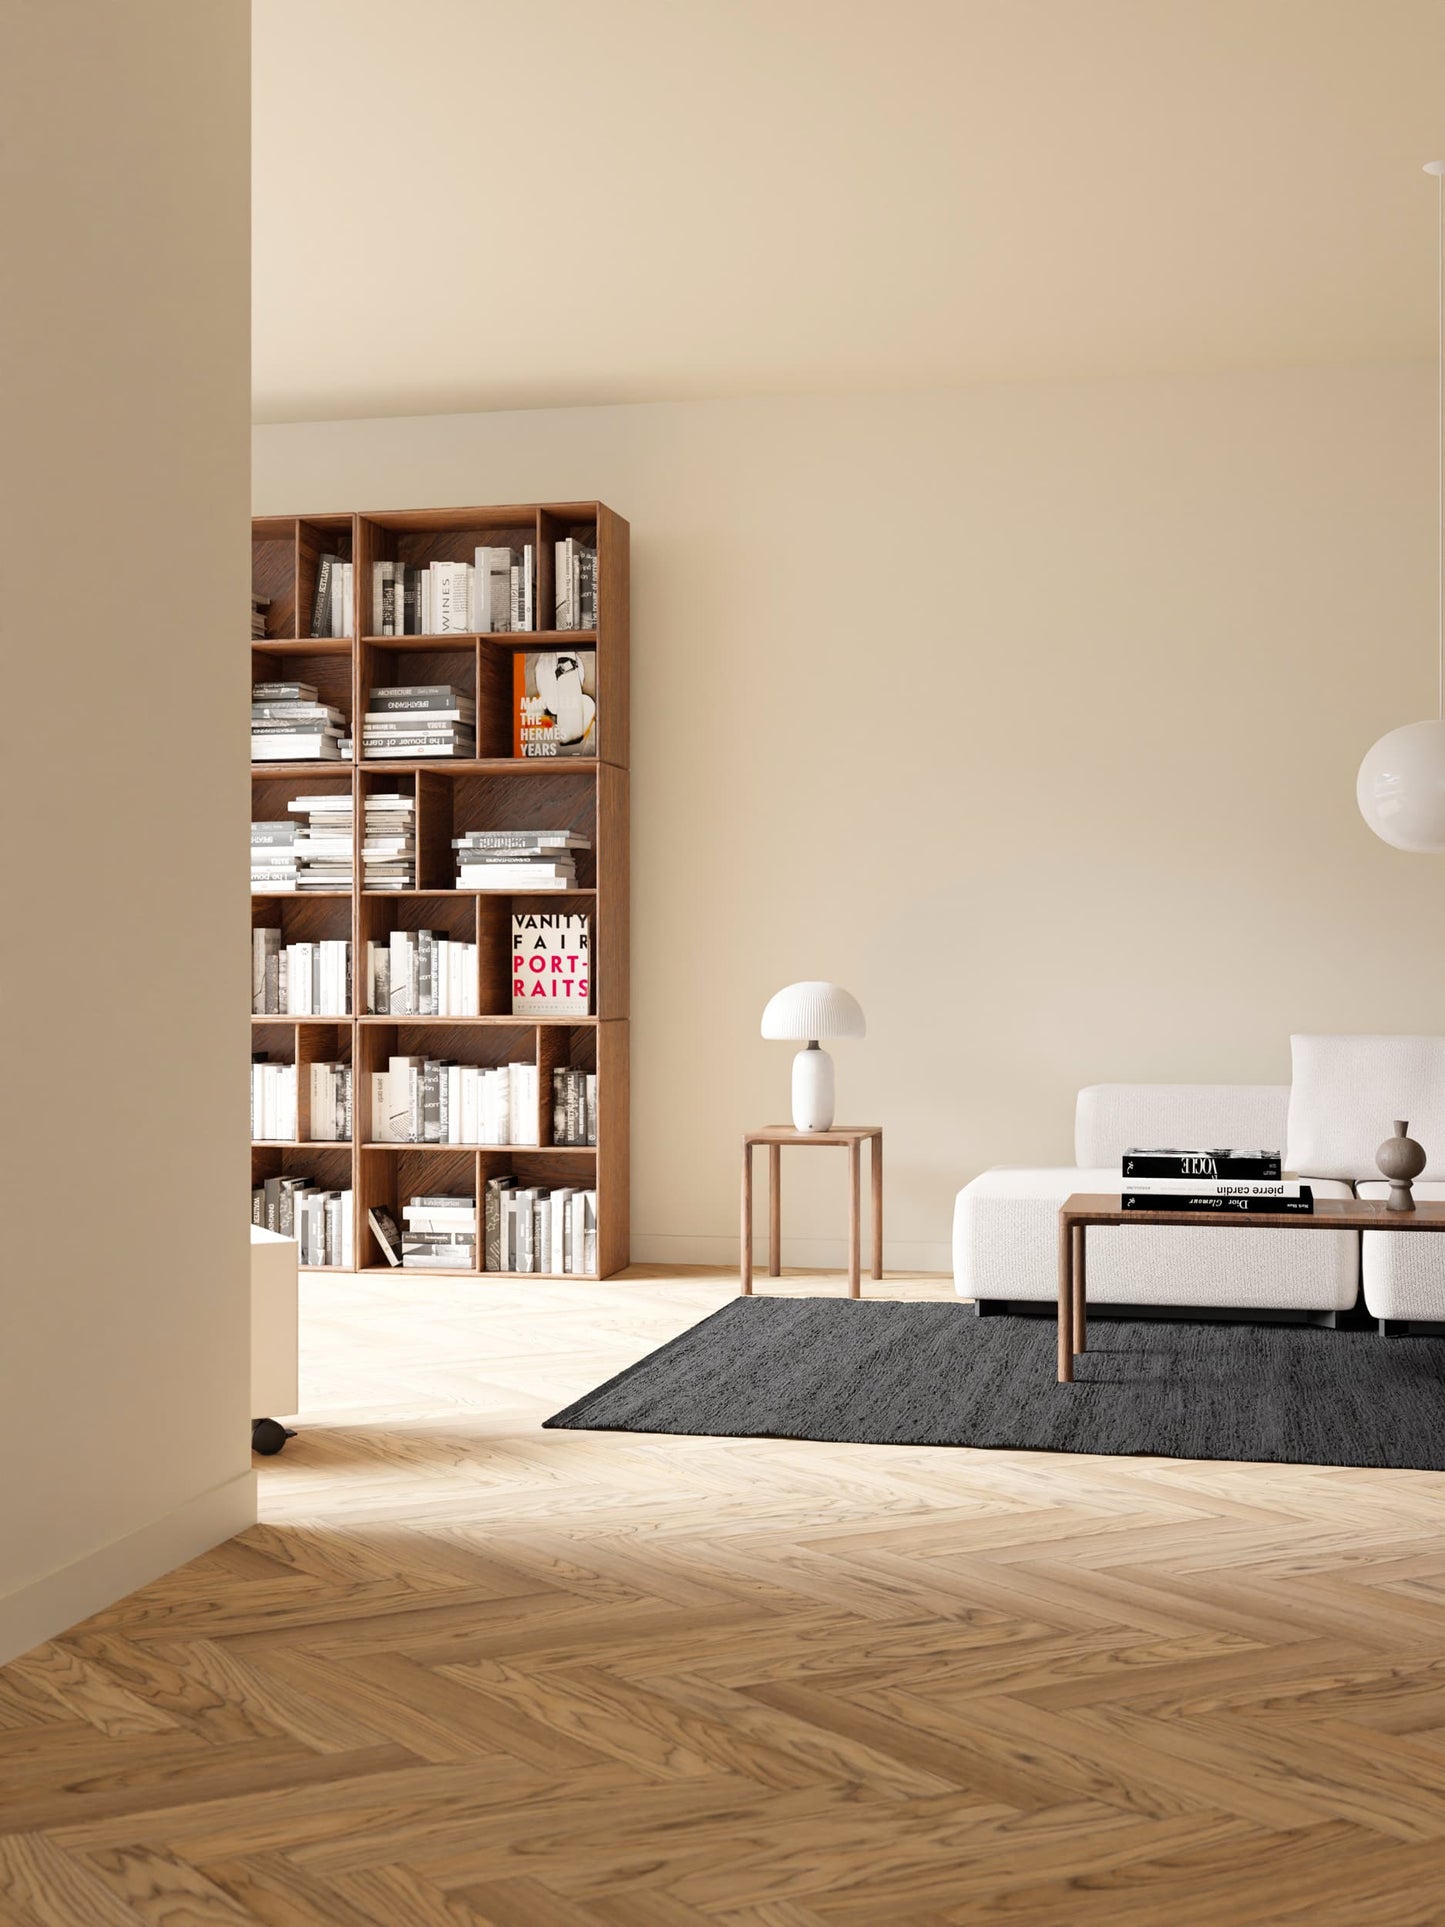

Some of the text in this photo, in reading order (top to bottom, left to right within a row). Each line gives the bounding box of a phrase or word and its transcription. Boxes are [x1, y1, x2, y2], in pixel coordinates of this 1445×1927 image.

[318, 560, 331, 594] WALTER
[441, 578, 451, 632] WINES
[377, 688, 412, 696] ARCHITECTURE
[388, 700, 430, 709] BREATHTAKING
[520, 712, 542, 726] THE
[398, 737, 427, 746] power
[520, 743, 557, 757] YEARS
[514, 914, 588, 929] VANITY
[513, 934, 588, 949] FAIR
[513, 955, 588, 973] PORT-
[513, 979, 588, 997] RAITS
[566, 1075, 575, 1141] MAGNETIC APPEAL
[1181, 1157, 1218, 1175] VOGUE
[1216, 1184, 1250, 1196] cardin
[1252, 1184, 1284, 1196] pierre
[1189, 1198, 1249, 1209] Dior Glamour
